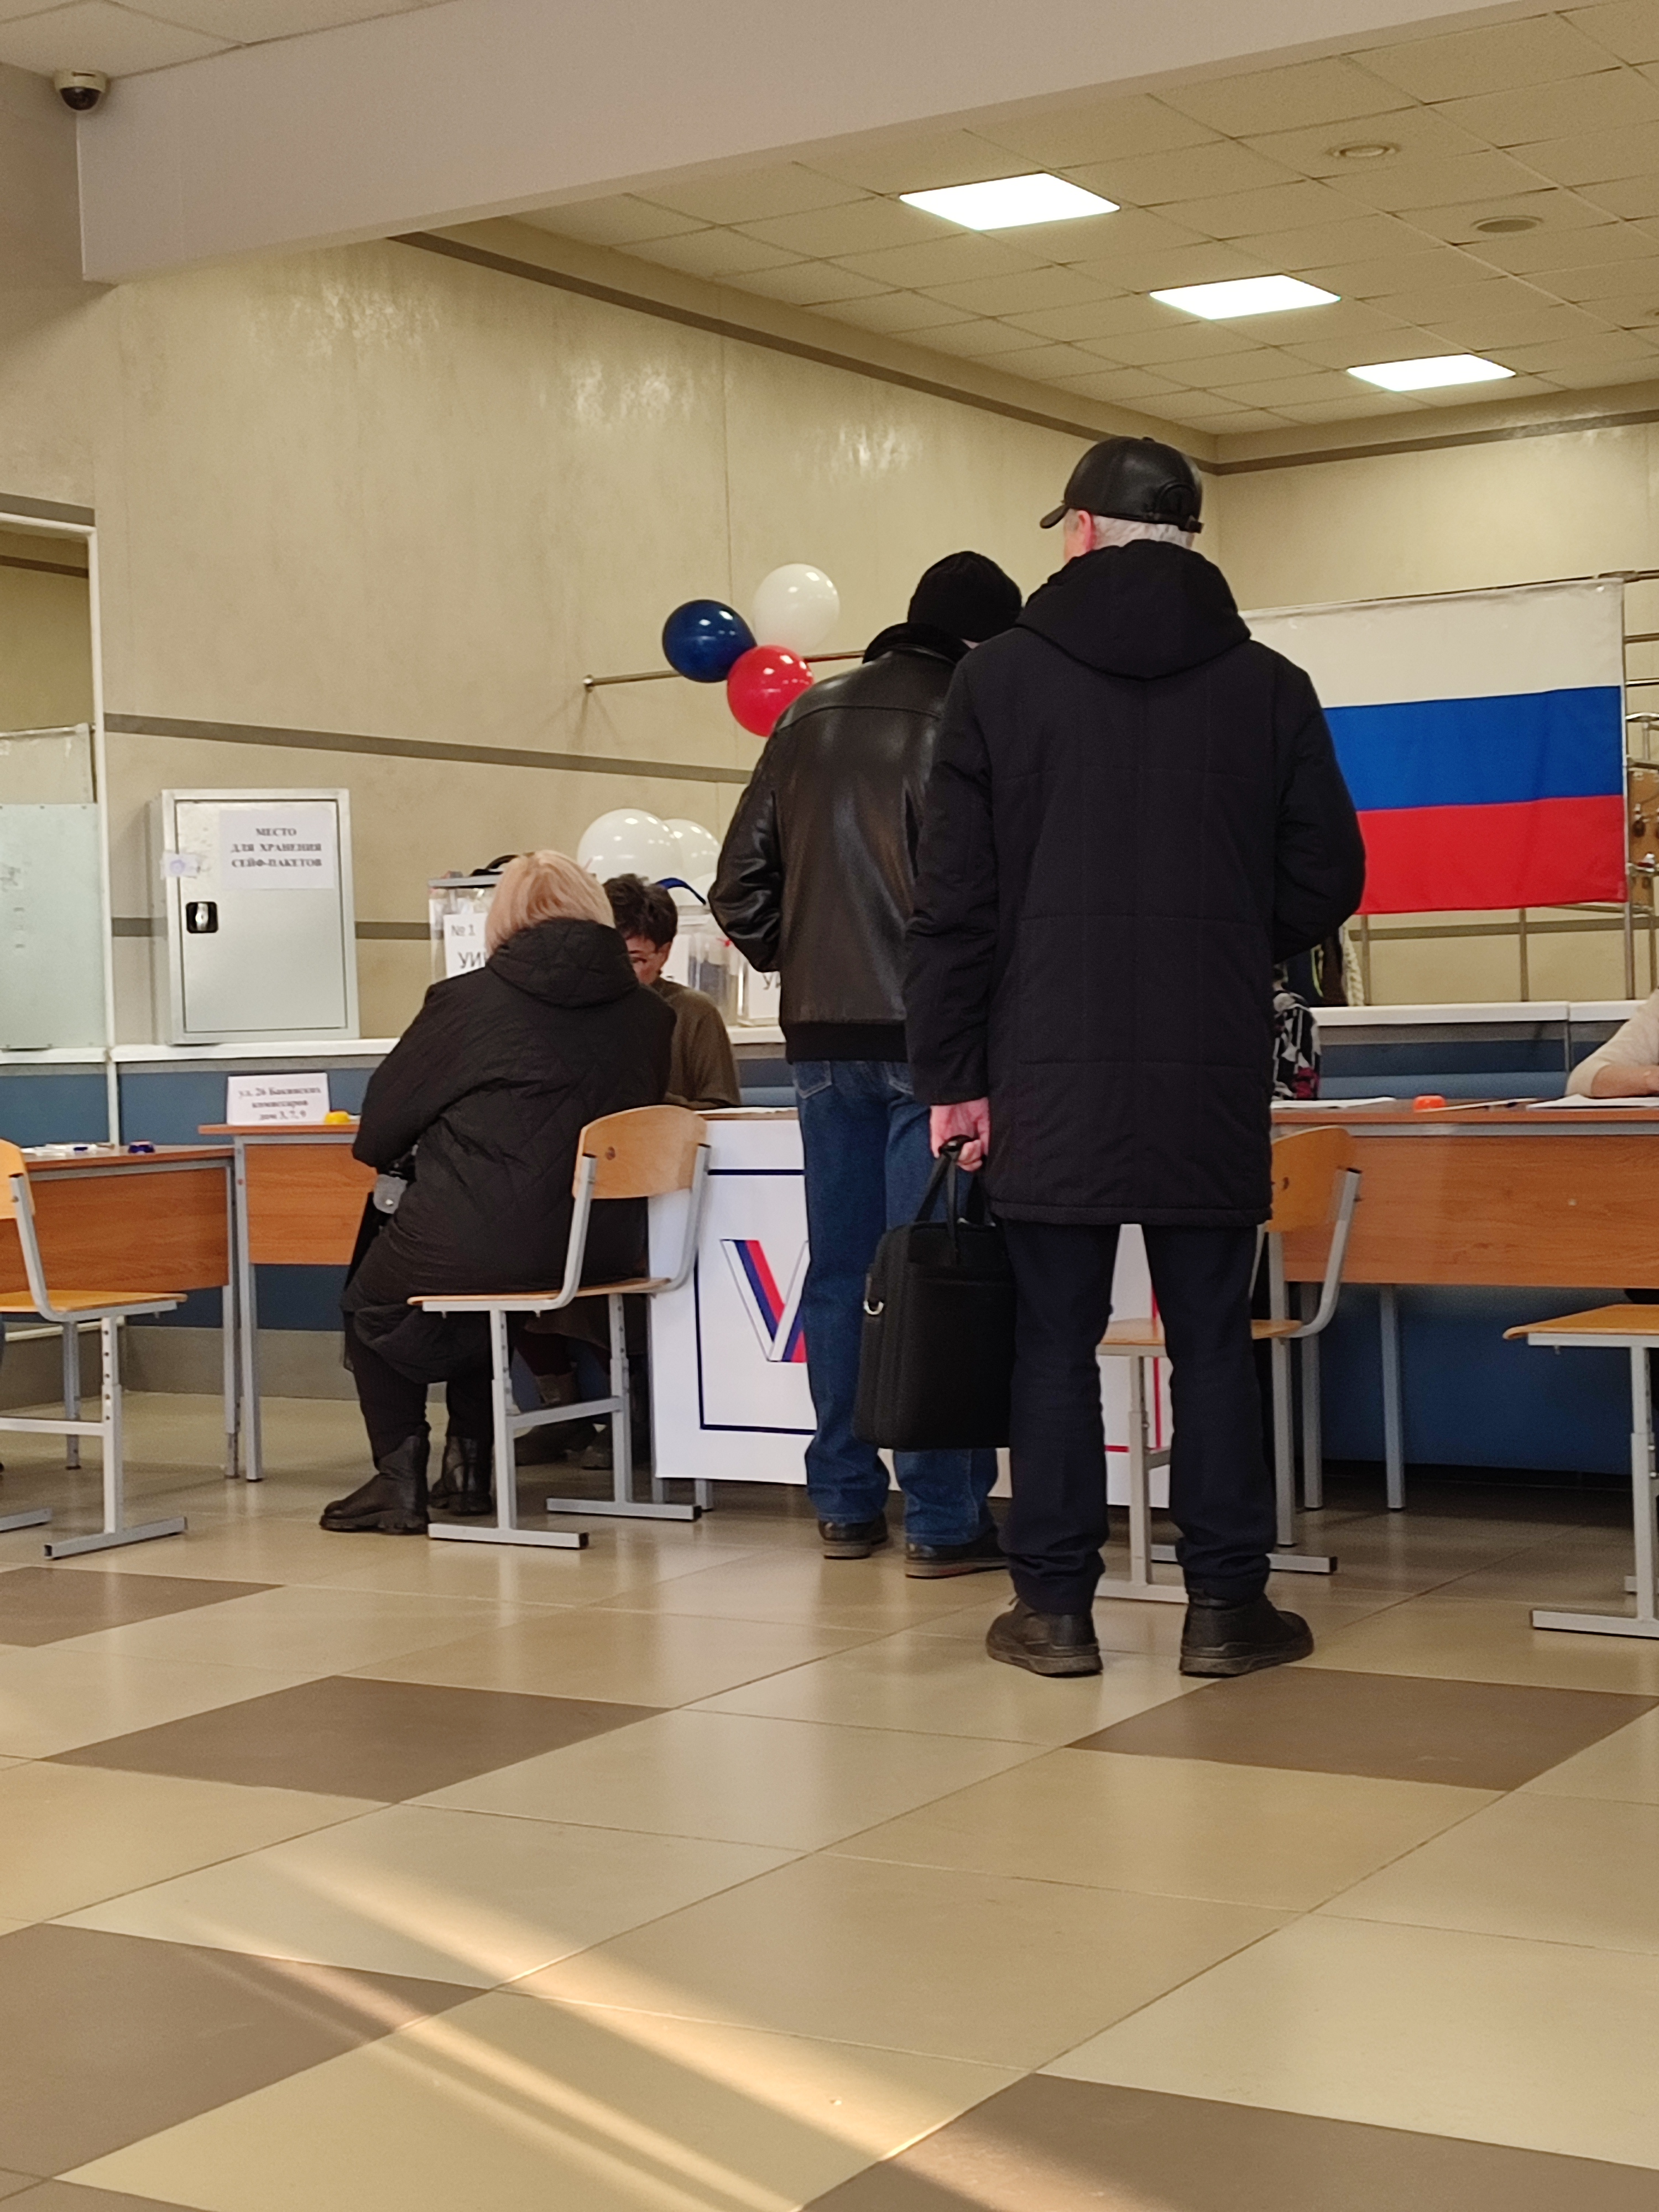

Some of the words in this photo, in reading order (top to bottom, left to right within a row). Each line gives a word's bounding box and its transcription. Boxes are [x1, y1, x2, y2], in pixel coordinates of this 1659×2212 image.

[255, 828, 297, 836] МЕСТО
[231, 843, 254, 852] ДЛЯ
[260, 843, 322, 852] ХРАНЕНИЯ
[231, 858, 322, 867] СЕЙФ-ПАКЕТОВ
[451, 925, 466, 936] №
